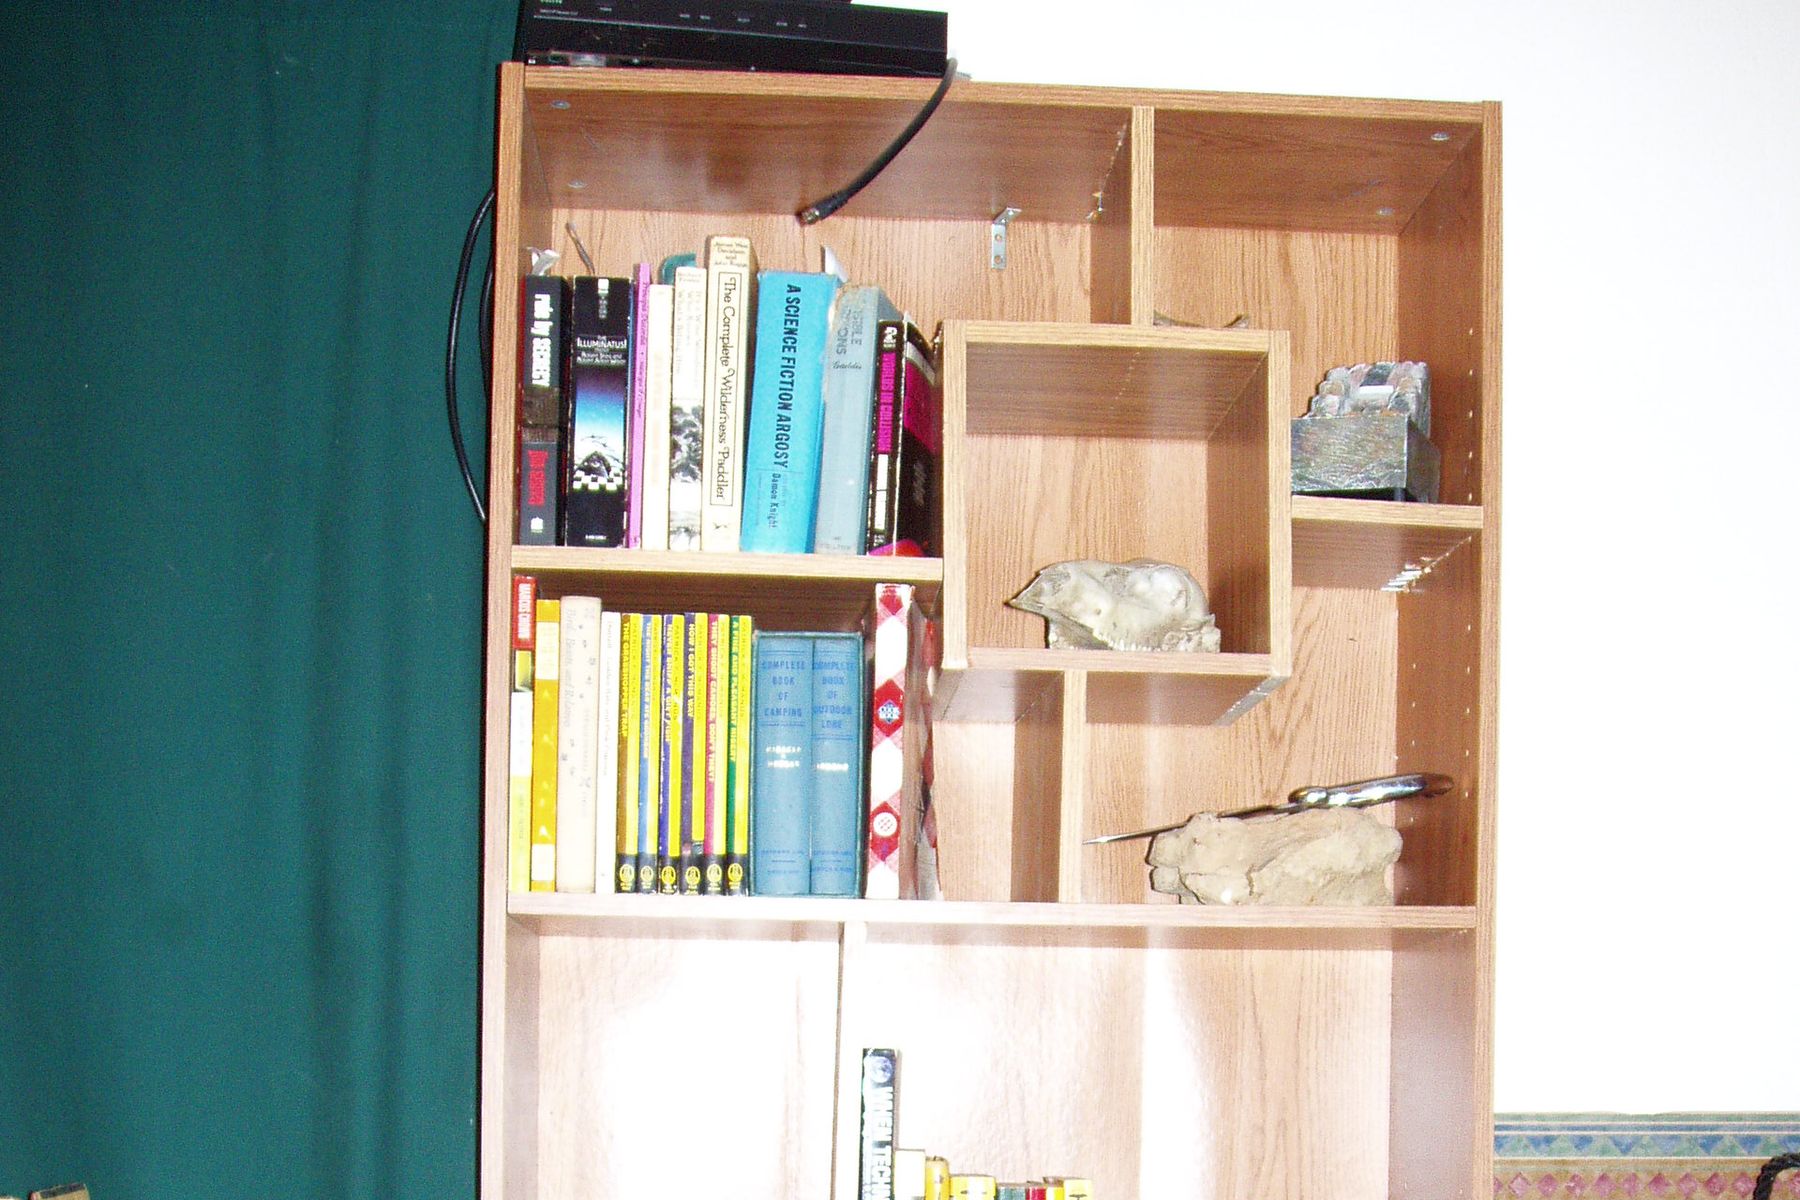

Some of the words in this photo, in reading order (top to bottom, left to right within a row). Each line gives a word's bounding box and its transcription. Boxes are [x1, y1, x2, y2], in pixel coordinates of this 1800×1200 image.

[724, 277, 736, 304] The
[786, 284, 802, 294] A
[530, 321, 553, 337] by
[720, 306, 736, 367] Complete
[781, 297, 801, 353] SCIENCE
[777, 357, 798, 411] FICTION
[881, 352, 896, 391] WORLDS
[718, 368, 735, 444] Wilderness
[880, 392, 895, 403] IN
[773, 414, 794, 469] ARGOSY
[877, 405, 893, 453] COLLISION
[715, 446, 731, 500] Paddler
[771, 473, 781, 500] Damon
[768, 503, 779, 528] Knight
[622, 623, 630, 641] THE
[621, 643, 630, 711] GRASSHOPPER
[760, 661, 806, 671] COMPLETE
[813, 661, 856, 671] COMPLETE
[772, 676, 796, 686] BOOK
[822, 676, 845, 685] BOOK
[730, 676, 738, 726] PLEASANT
[778, 691, 790, 701] OF
[827, 690, 839, 699] OF
[764, 708, 803, 717] CAMPING
[812, 705, 853, 714] OUTDOOR
[872, 1087, 894, 1140] WHEN
